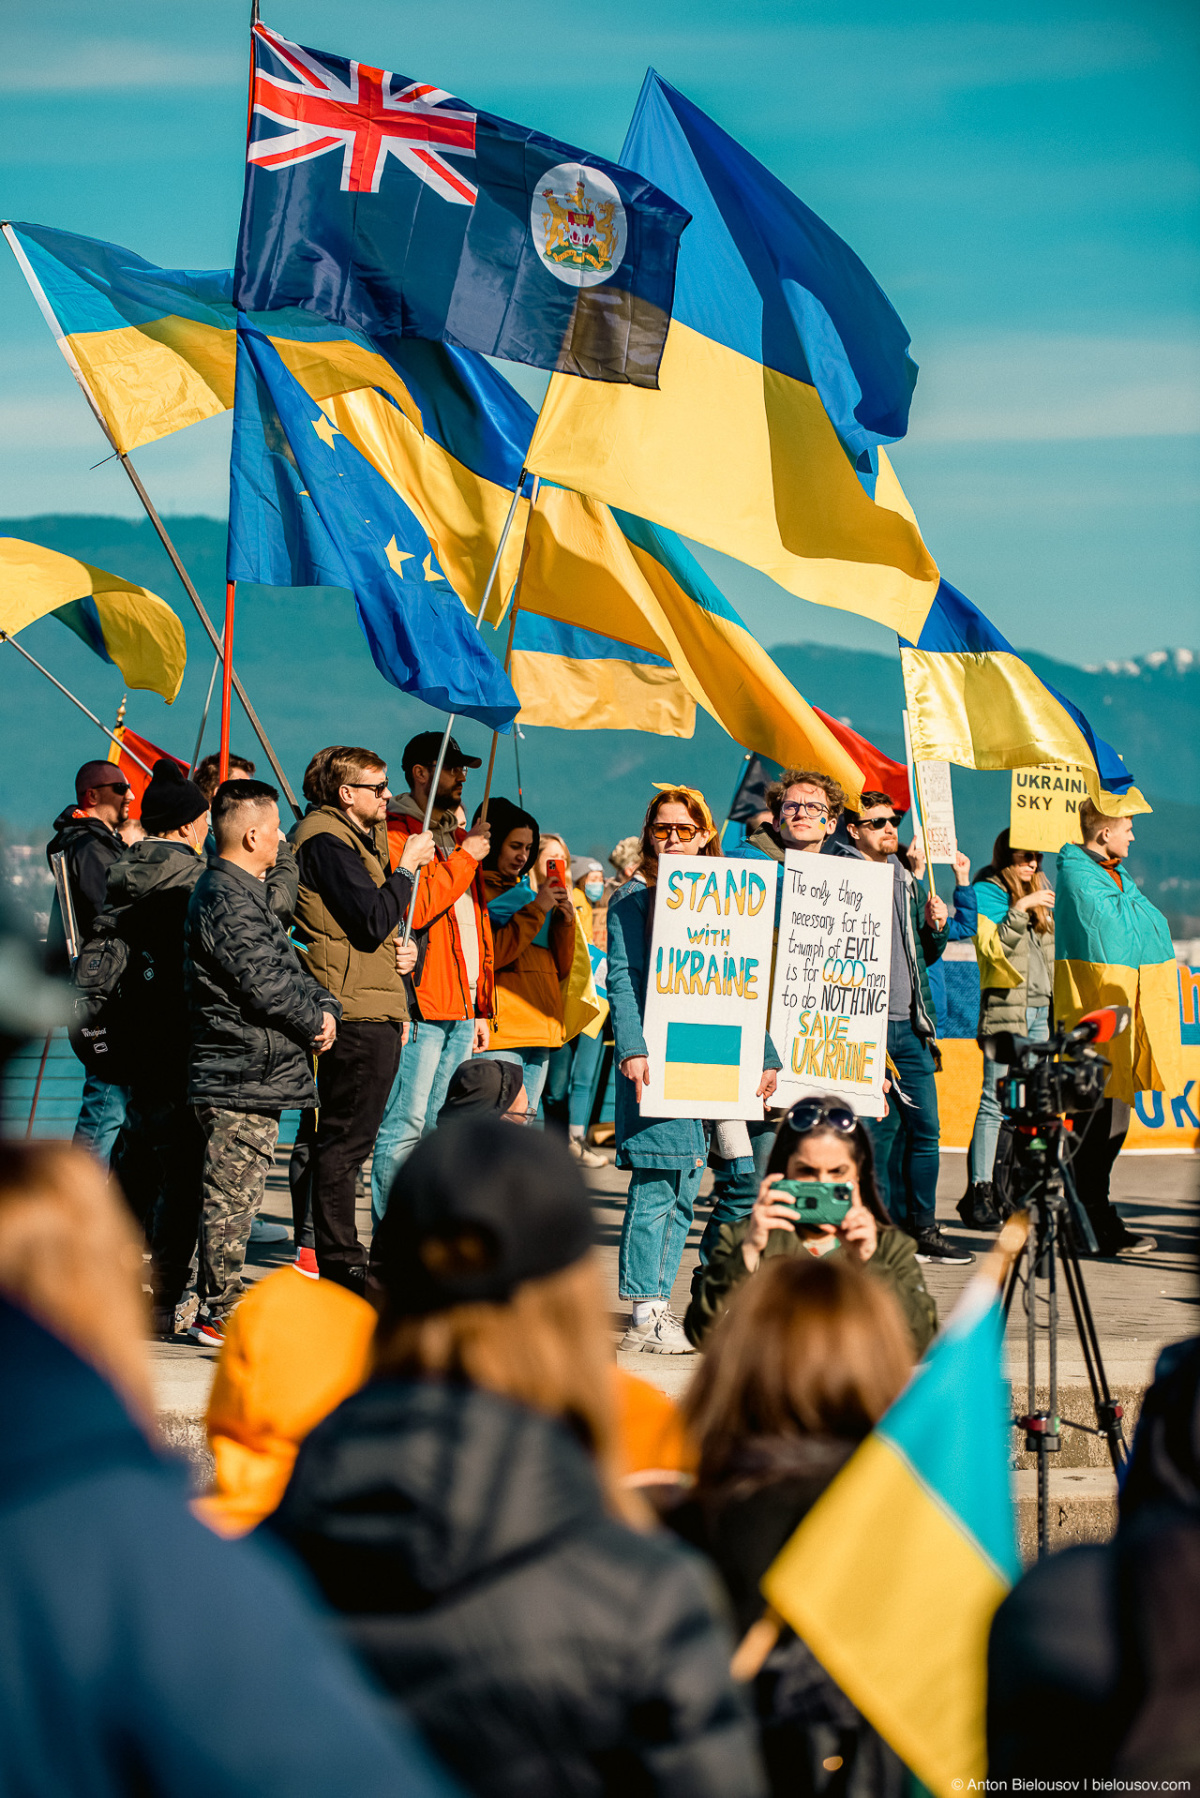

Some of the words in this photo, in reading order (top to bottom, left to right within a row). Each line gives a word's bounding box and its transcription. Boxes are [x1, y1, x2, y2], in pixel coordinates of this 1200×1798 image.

[1017, 795, 1052, 810] SKY
[666, 869, 766, 916] STAND
[787, 868, 807, 896] The
[810, 880, 831, 906] only
[838, 879, 863, 912] thing
[791, 911, 835, 936] necessary
[841, 911, 857, 933] for
[861, 913, 881, 938] the
[828, 938, 842, 959] of
[844, 936, 878, 962] EVIL
[786, 963, 798, 981] is
[803, 957, 819, 983] for
[822, 957, 866, 987] GOOD
[866, 972, 886, 988] men
[782, 984, 798, 1008] to
[801, 983, 817, 1010] do
[820, 984, 887, 1016] NOTHING
[798, 1009, 850, 1042] SAVE
[791, 1036, 877, 1085] UKRAINE
